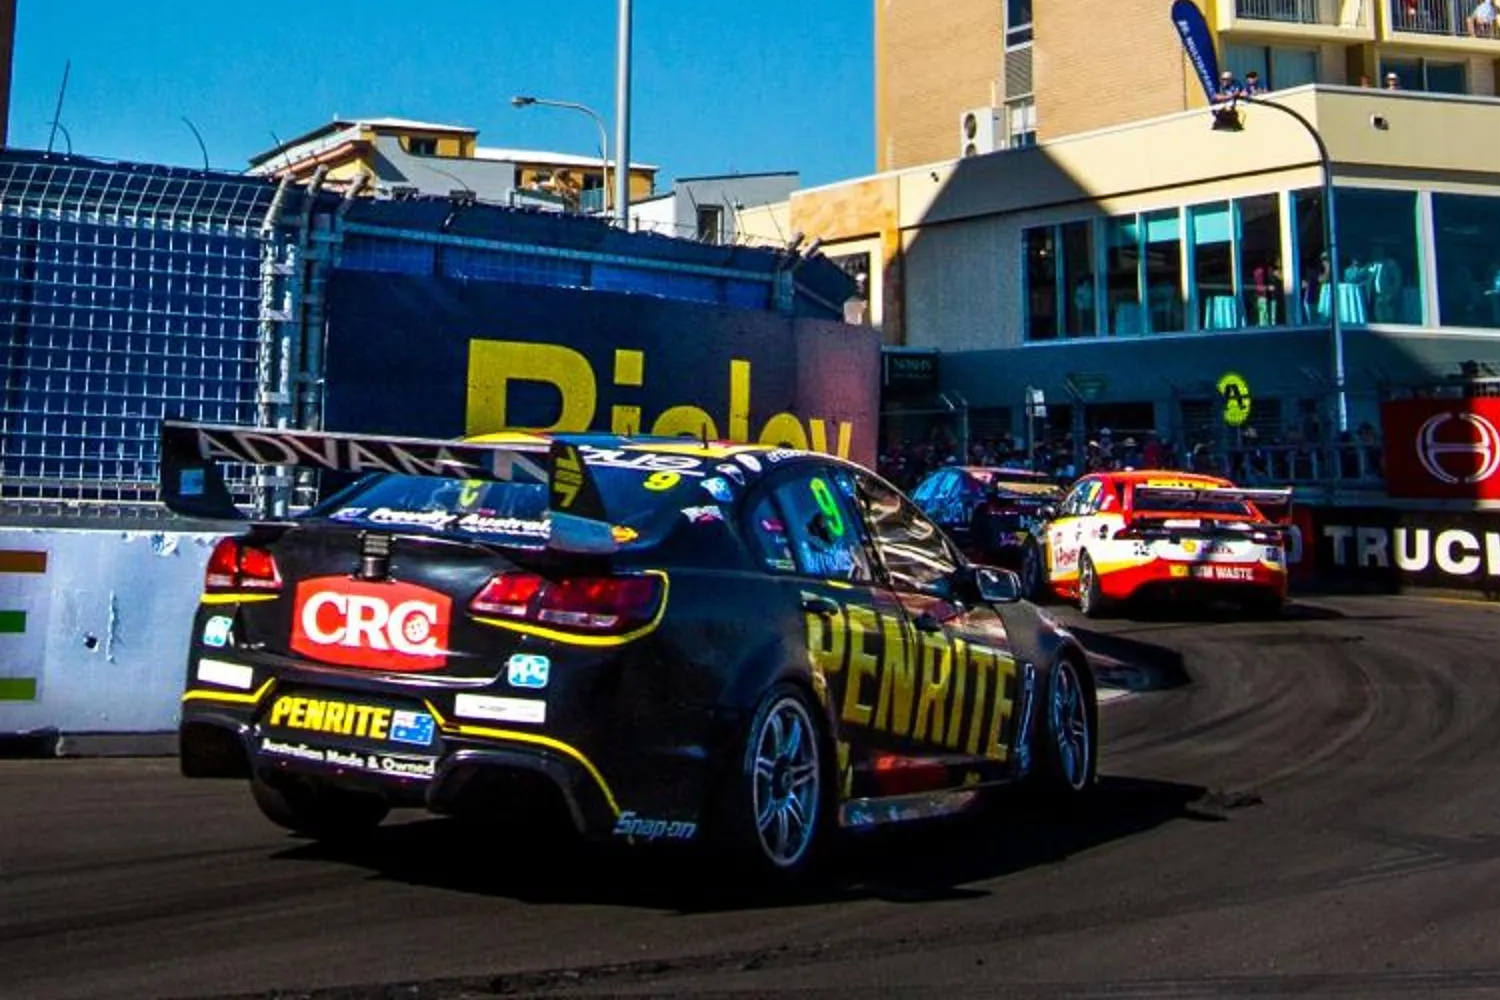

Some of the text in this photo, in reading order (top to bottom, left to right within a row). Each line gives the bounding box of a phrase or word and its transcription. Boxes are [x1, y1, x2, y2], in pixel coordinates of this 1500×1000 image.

[810, 477, 844, 537] 9
[302, 591, 438, 656] CRC
[804, 604, 1017, 762] PENRITE
[269, 696, 392, 739] PENRITE
[384, 758, 435, 776] Owned
[613, 811, 697, 840] Snap-on
